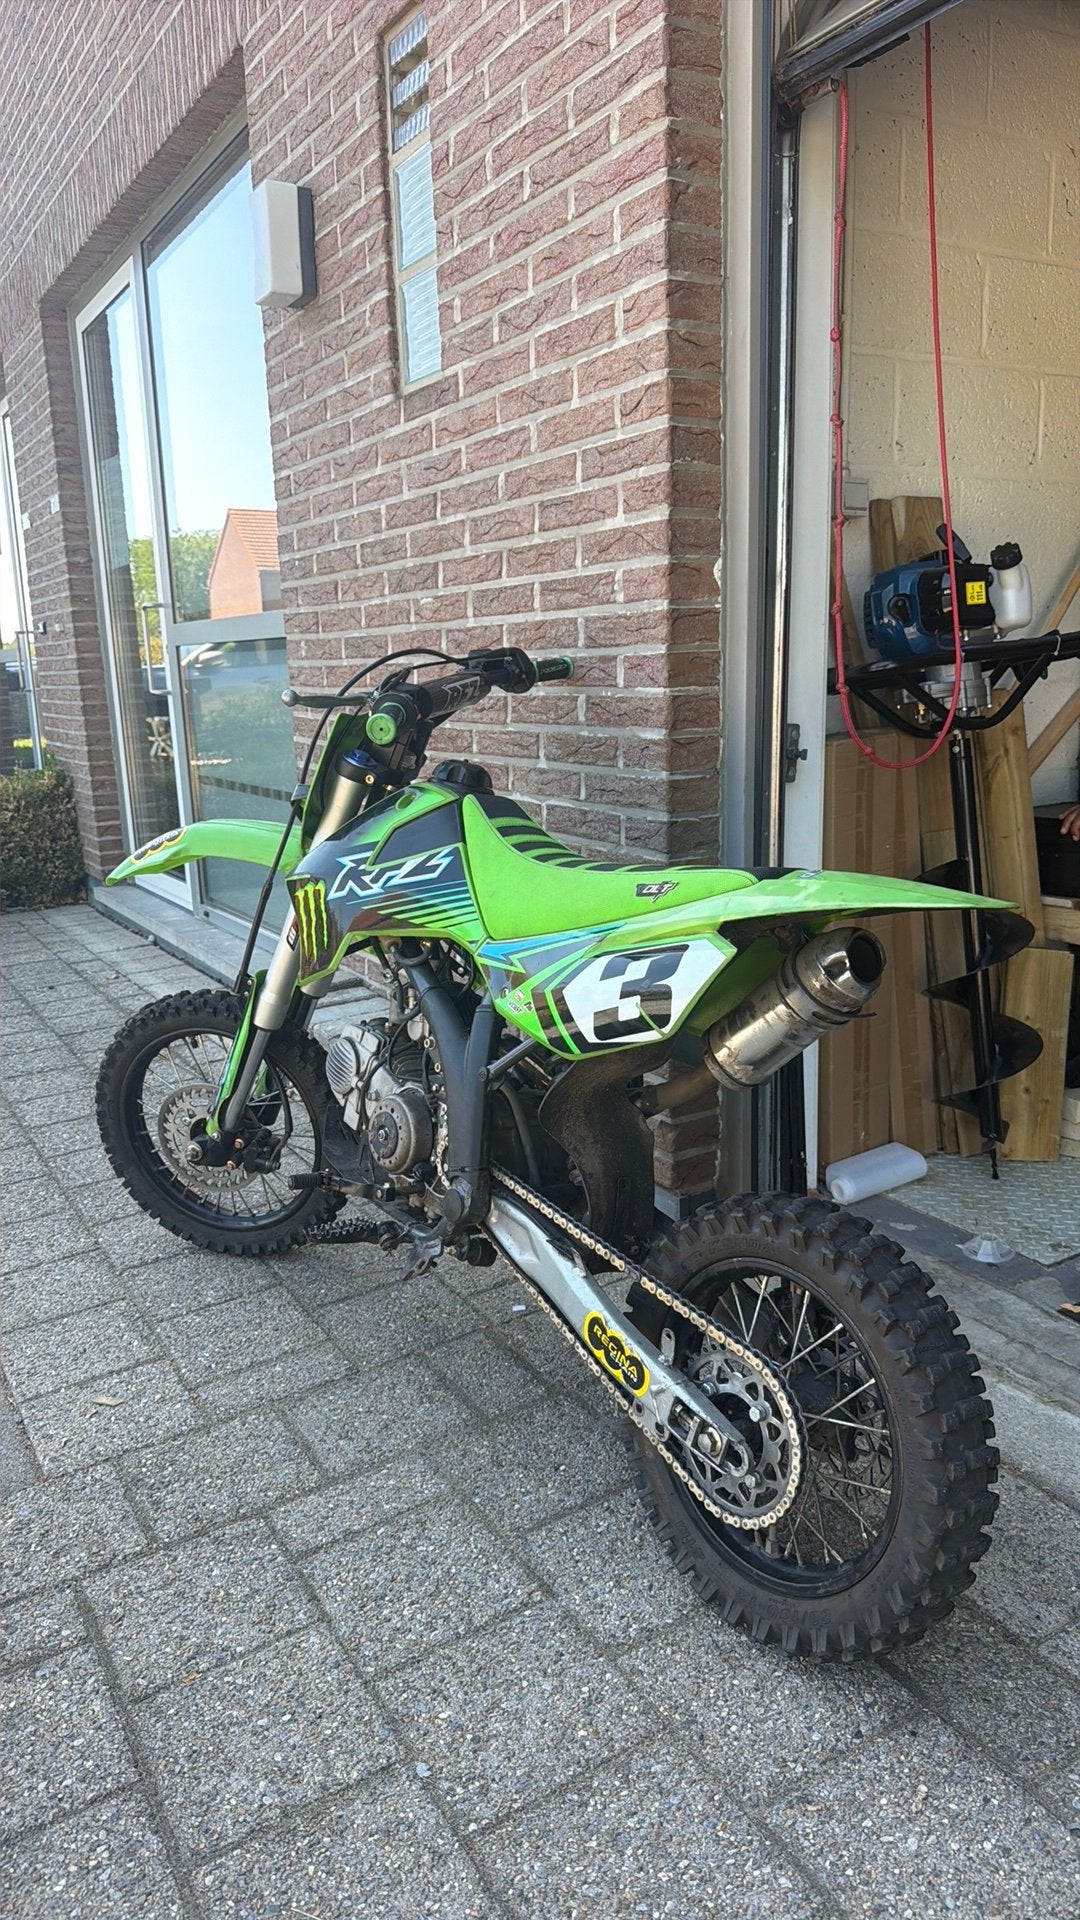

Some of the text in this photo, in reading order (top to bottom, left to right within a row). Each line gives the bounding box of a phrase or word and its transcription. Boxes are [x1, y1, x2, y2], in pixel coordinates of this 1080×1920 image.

[593, 943, 690, 1041] 3
[593, 1324, 638, 1378] REGINA
[609, 1352, 638, 1383] CHAIN
